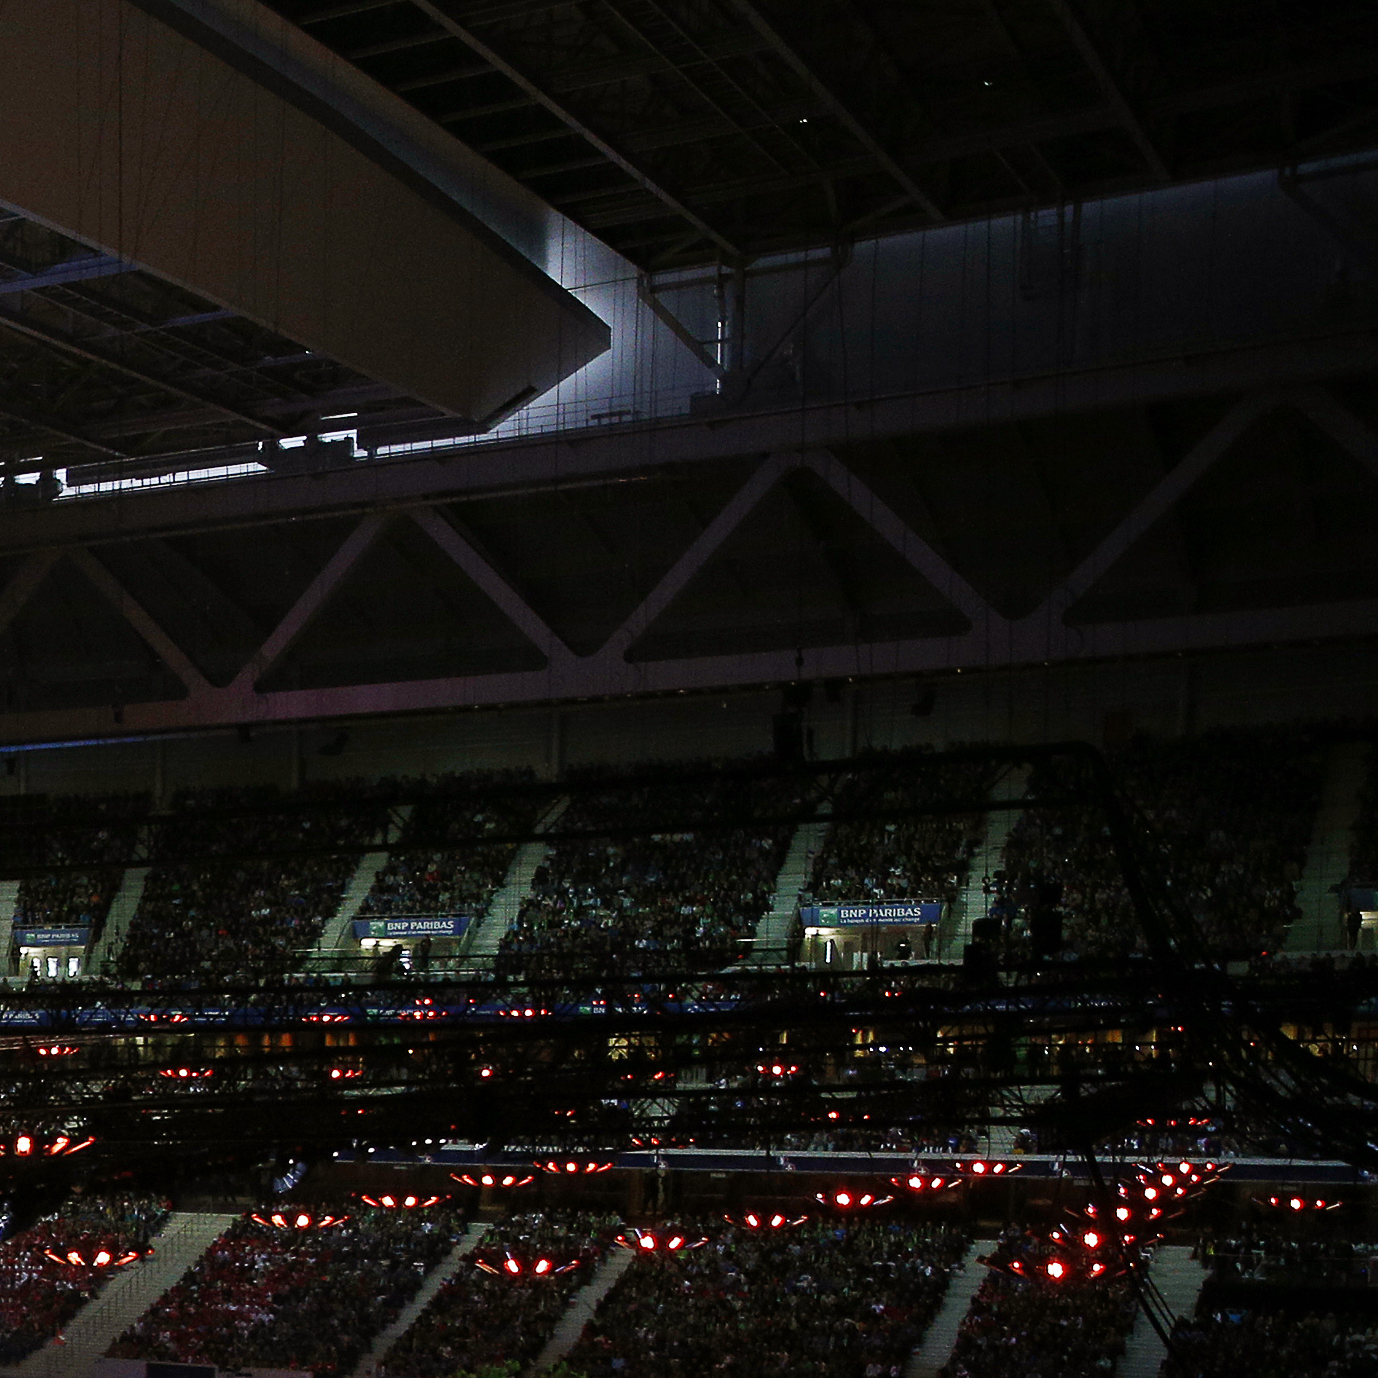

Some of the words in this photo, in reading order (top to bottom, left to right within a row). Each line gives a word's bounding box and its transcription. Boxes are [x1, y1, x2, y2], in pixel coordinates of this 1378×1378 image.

[840, 908, 866, 918] BNP
[868, 907, 922, 917] PARIBAS
[387, 922, 409, 931] BNP
[410, 921, 454, 930] PARIBAS
